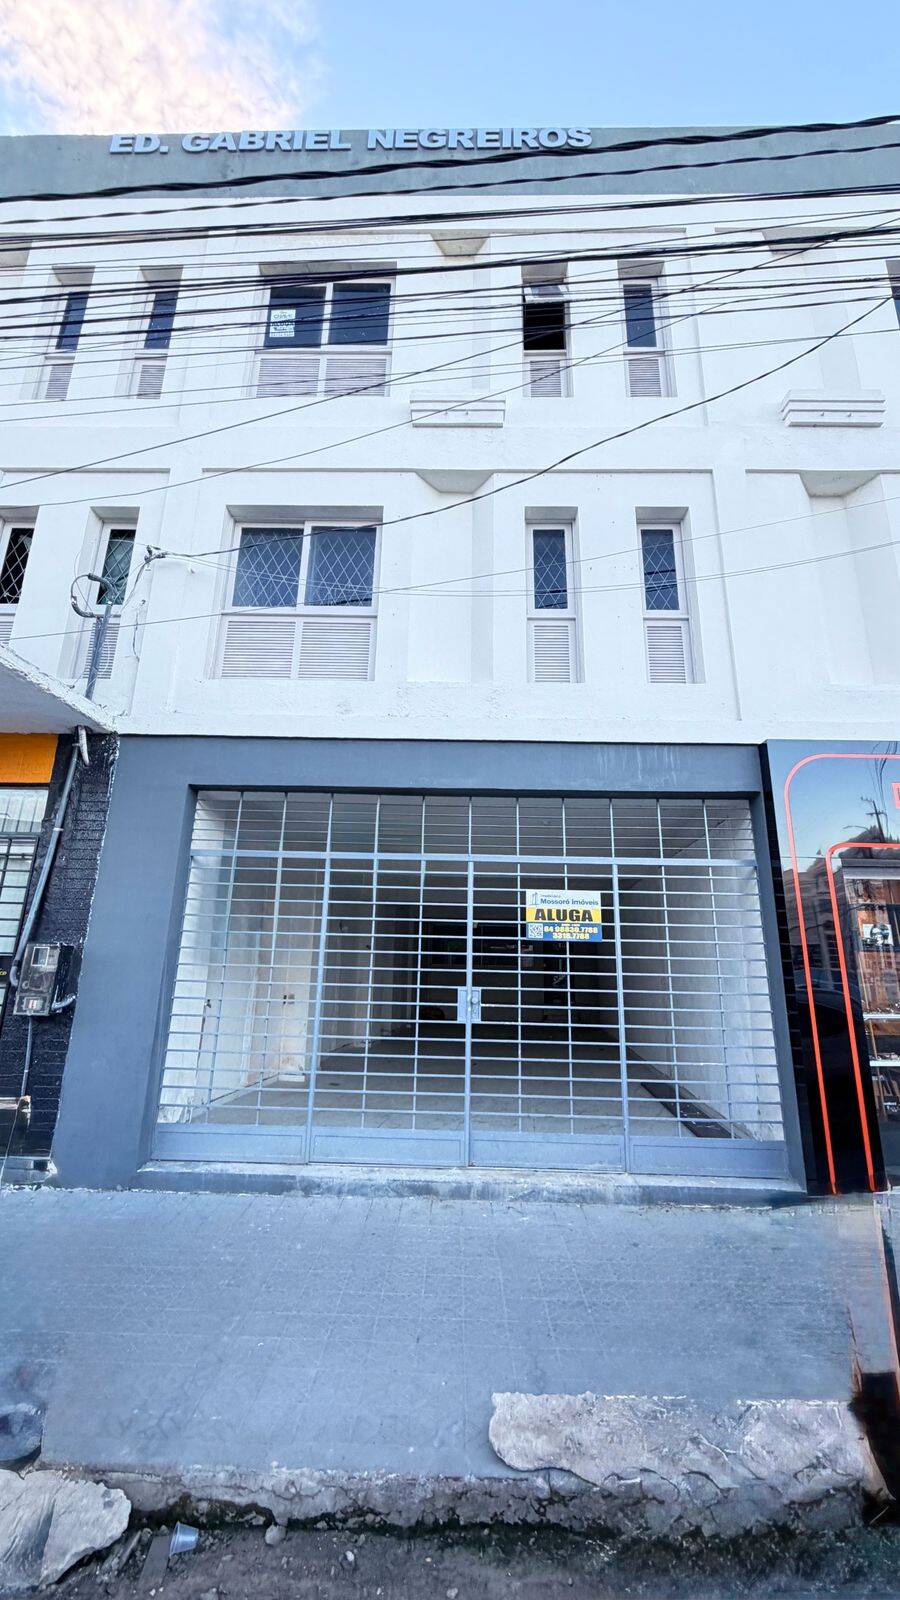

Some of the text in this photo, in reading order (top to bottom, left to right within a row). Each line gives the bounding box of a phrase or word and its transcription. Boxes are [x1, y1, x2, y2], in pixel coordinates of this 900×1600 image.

[109, 127, 593, 154] ED. GABRIEL NEGREIROS
[534, 908, 593, 922] ALUGA
